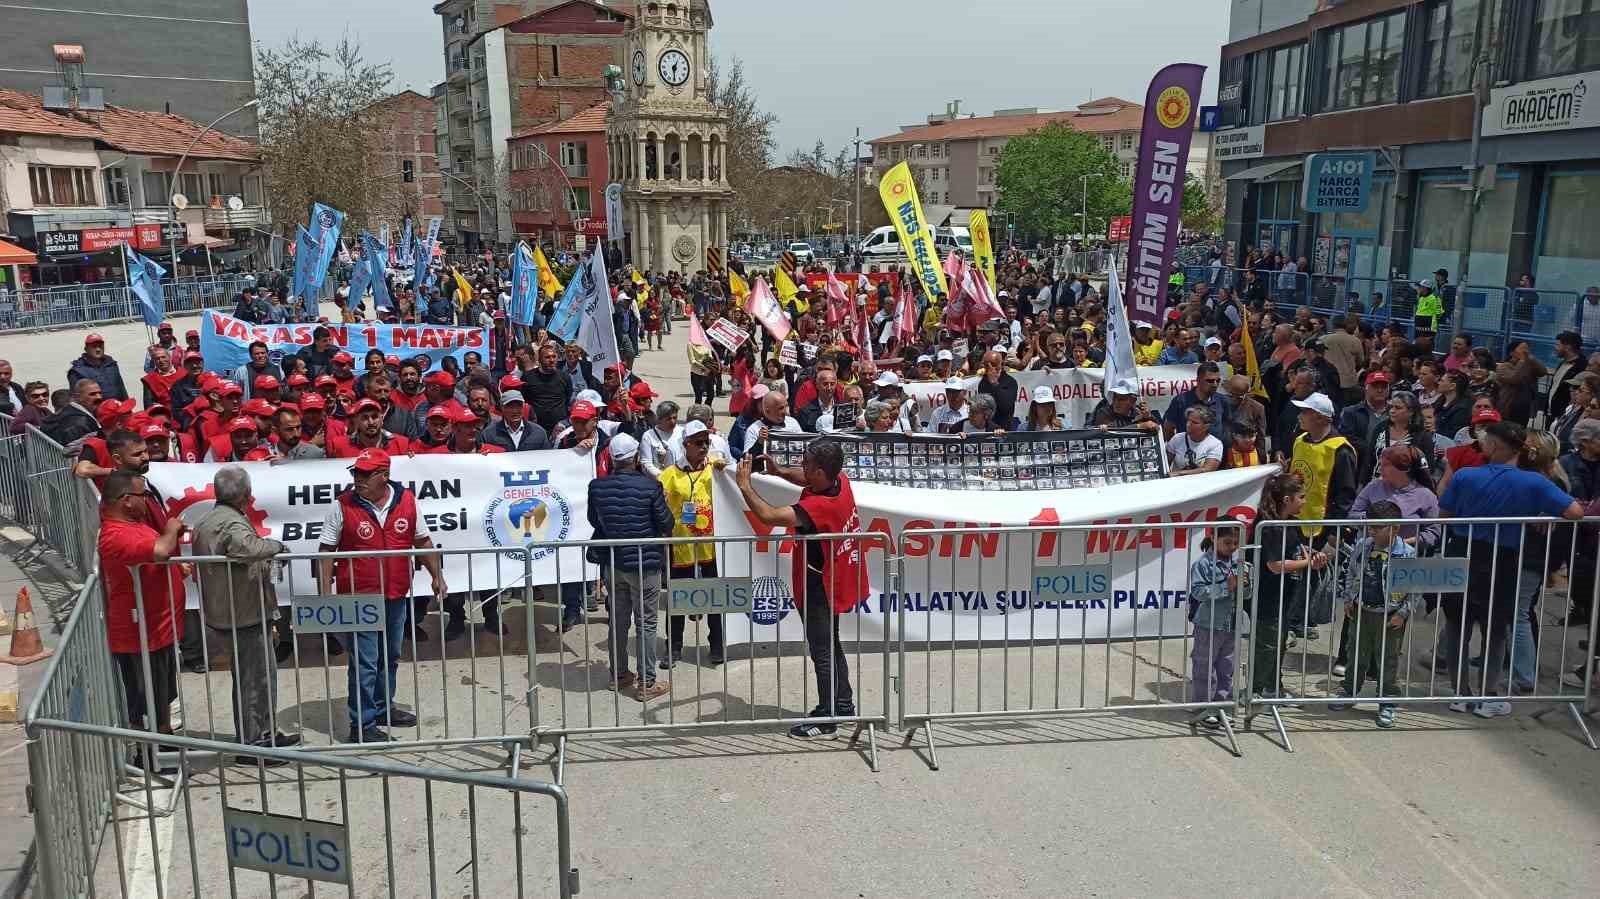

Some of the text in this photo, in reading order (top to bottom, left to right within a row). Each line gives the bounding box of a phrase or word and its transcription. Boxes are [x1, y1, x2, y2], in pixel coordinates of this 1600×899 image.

[1149, 140, 1180, 205] SEN
[1319, 177, 1361, 186] HARCA
[1318, 187, 1360, 196] HARCA
[1131, 212, 1169, 316] EĞİTİM
[211, 312, 483, 350] YAŞASN 1 MAYIS
[1029, 507, 1061, 557] 1
[1036, 571, 1107, 596] POLİS
[672, 584, 748, 609] POLİS
[880, 591, 989, 613] MALATYA
[296, 601, 380, 626] POLİS
[230, 826, 340, 873] POLİS
